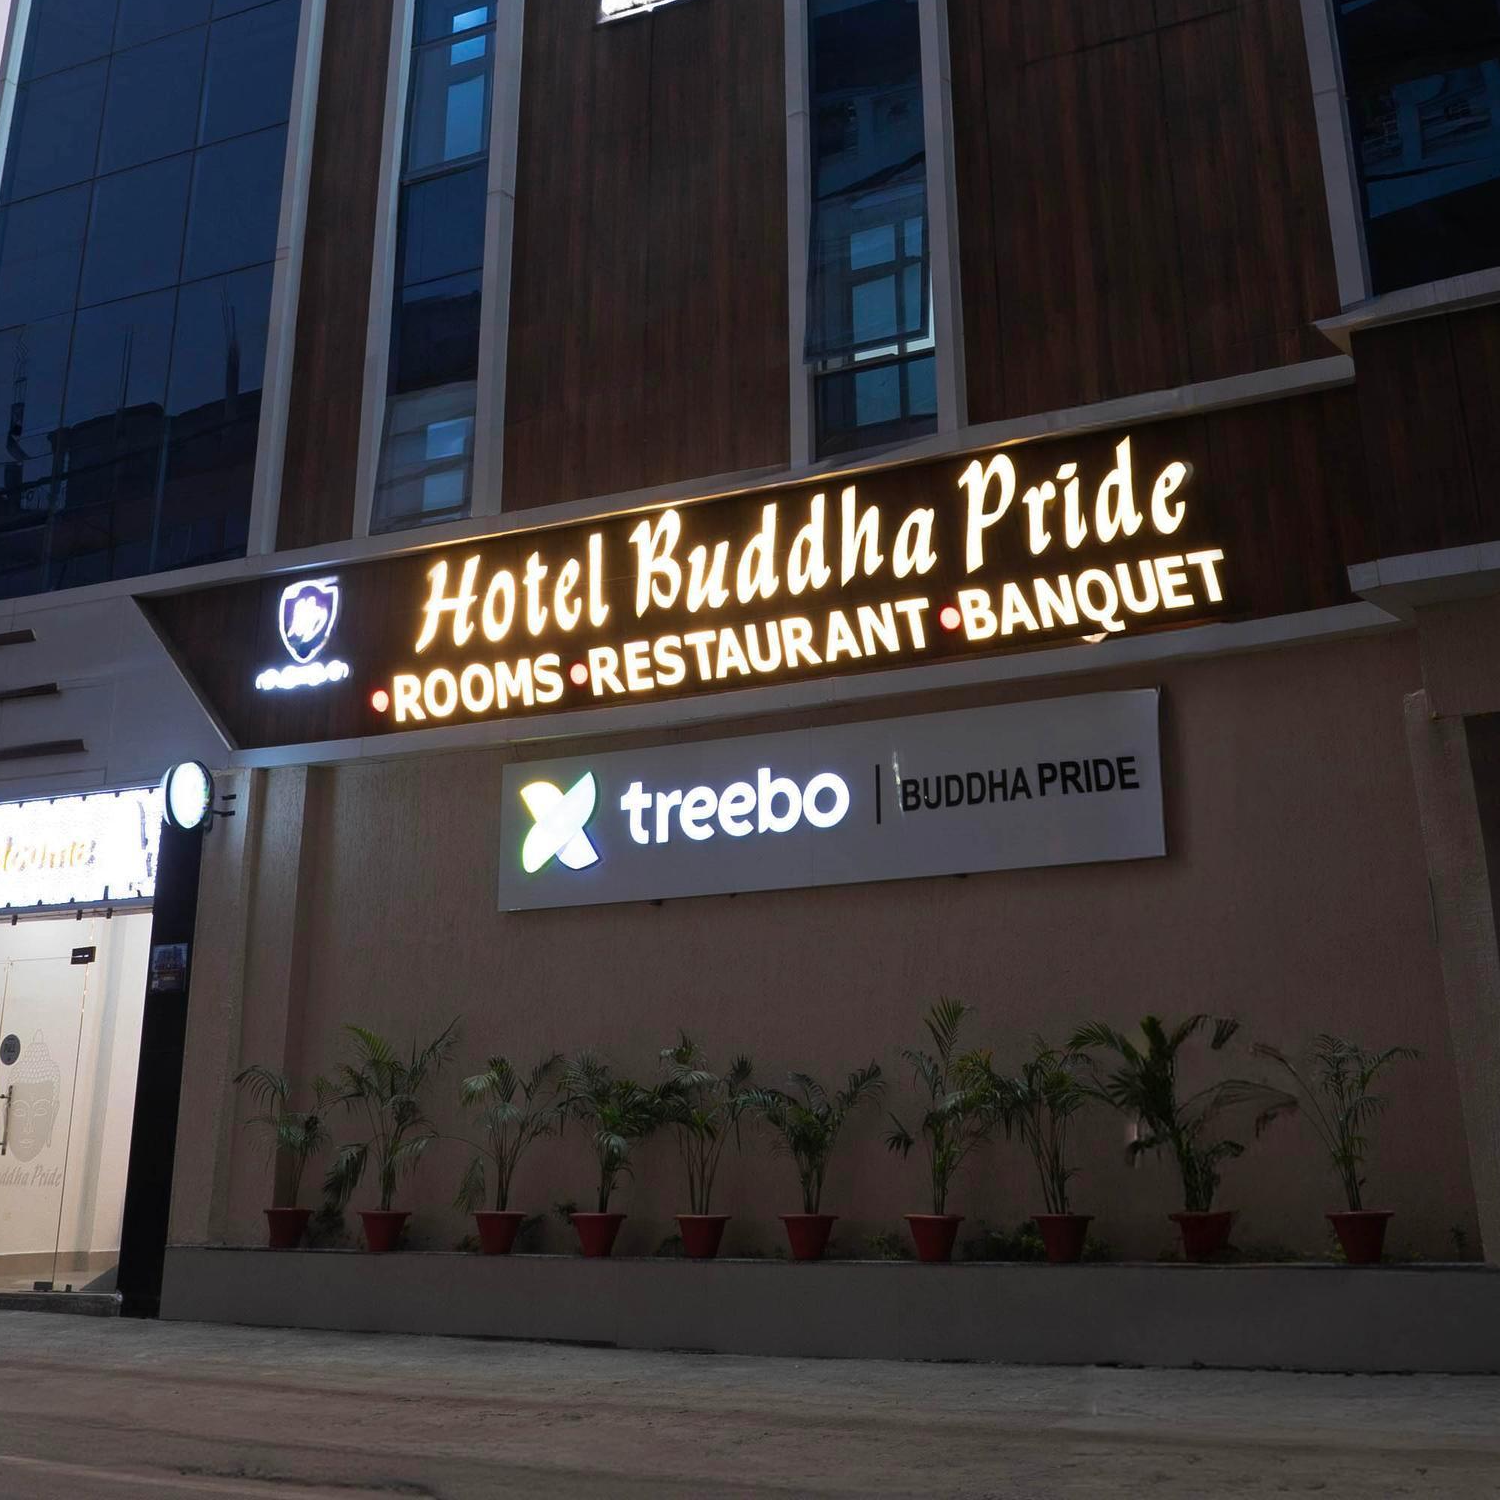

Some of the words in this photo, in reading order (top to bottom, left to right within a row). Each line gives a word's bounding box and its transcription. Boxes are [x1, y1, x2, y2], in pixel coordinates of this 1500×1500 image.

[414, 532, 609, 654] Hotel
[628, 485, 939, 618] Buddha
[957, 434, 1188, 574] Pride
[391, 652, 564, 723] ROOMS
[587, 597, 931, 697] RESTAURANT
[957, 548, 1225, 641] BANQUET
[620, 766, 851, 845] treebo
[902, 766, 1033, 812] BUDDHA
[1038, 755, 1140, 797] PRIDE
[30, 1163, 63, 1188] Pride
